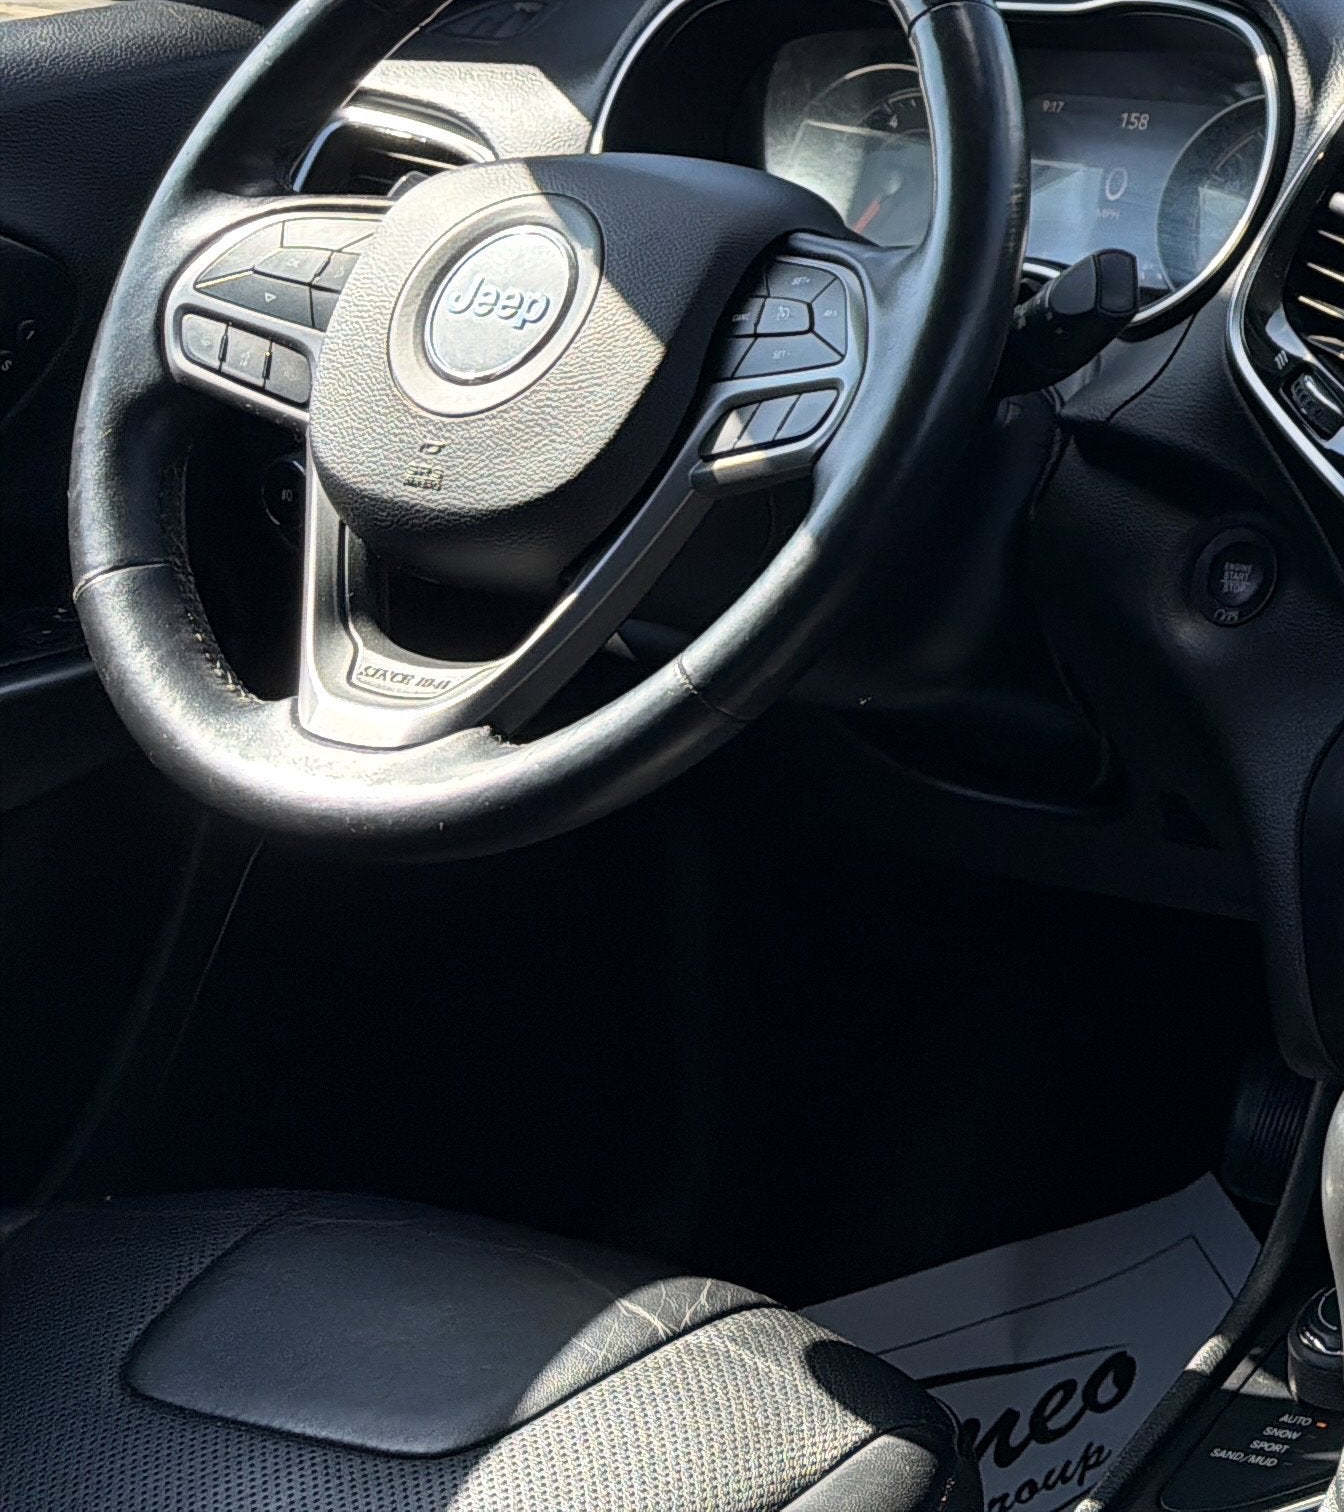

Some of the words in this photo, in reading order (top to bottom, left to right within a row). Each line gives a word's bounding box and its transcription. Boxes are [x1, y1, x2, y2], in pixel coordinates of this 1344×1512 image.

[1119, 111, 1150, 131] 158
[1105, 167, 1128, 201] 0
[446, 273, 551, 331] Jeep
[1278, 1412, 1313, 1428] AUTO
[1262, 1425, 1303, 1441] SNOW
[1249, 1438, 1292, 1456] SPORT
[1208, 1447, 1279, 1468] SAND/MUD
